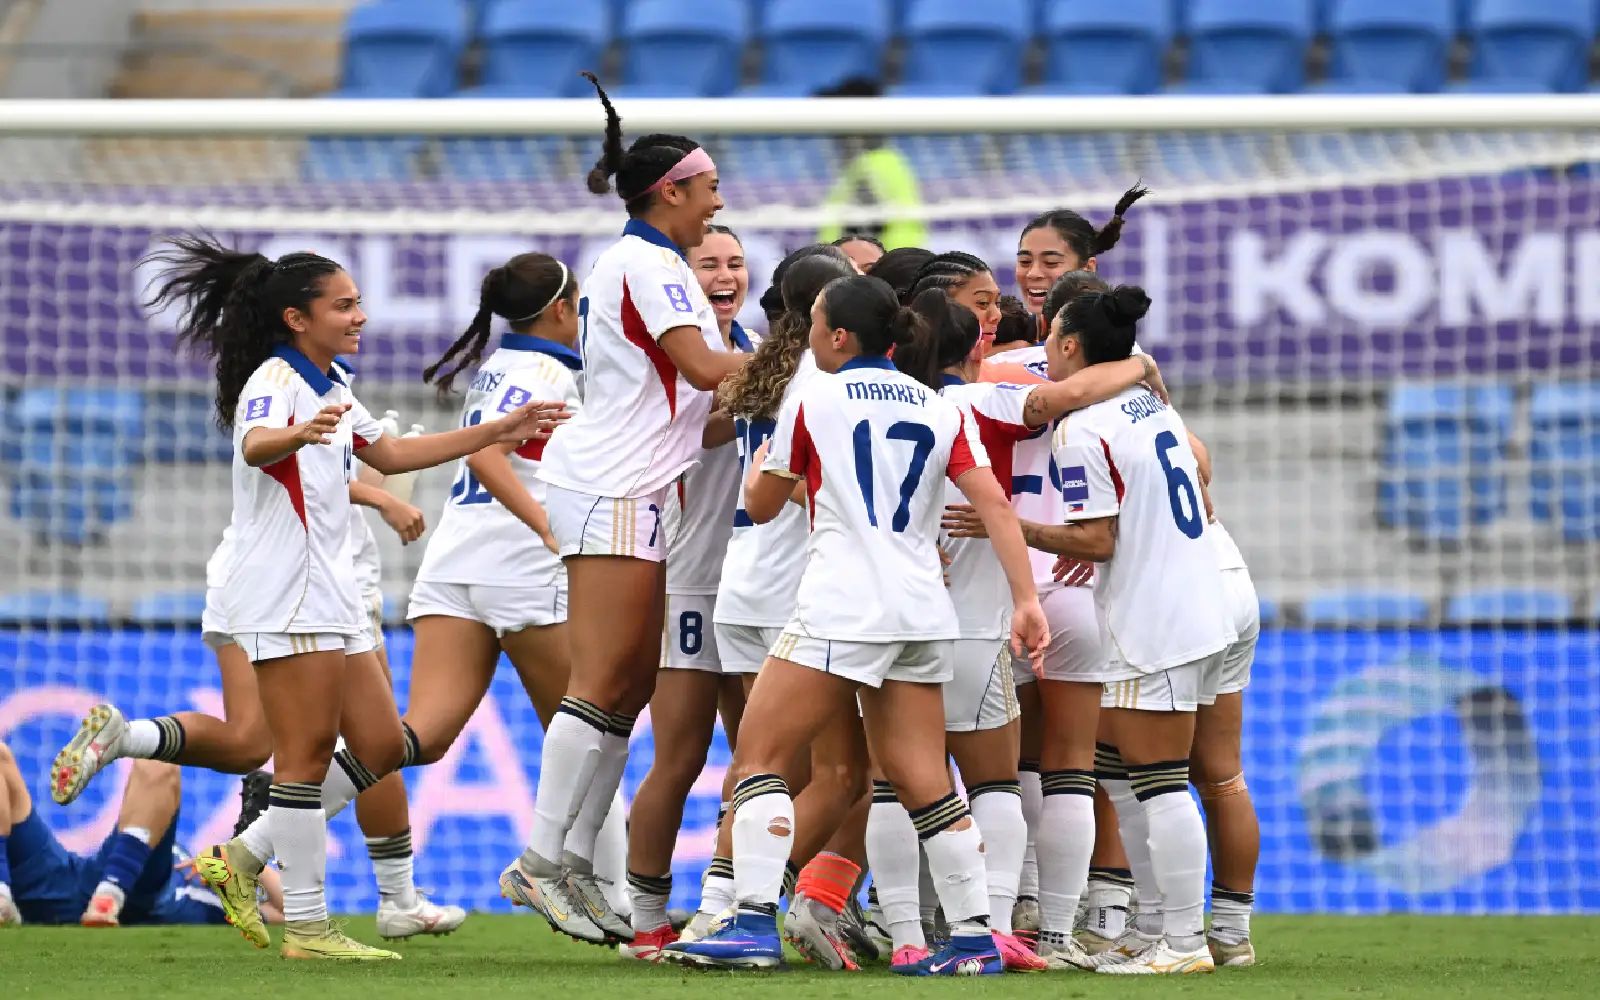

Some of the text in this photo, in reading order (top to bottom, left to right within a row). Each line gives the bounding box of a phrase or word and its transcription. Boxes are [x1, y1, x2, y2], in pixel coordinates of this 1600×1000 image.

[845, 382, 928, 407] MARKEY
[852, 419, 936, 533] 17
[1155, 430, 1204, 540] 6
[649, 503, 660, 547] 7
[679, 610, 703, 655] 8
